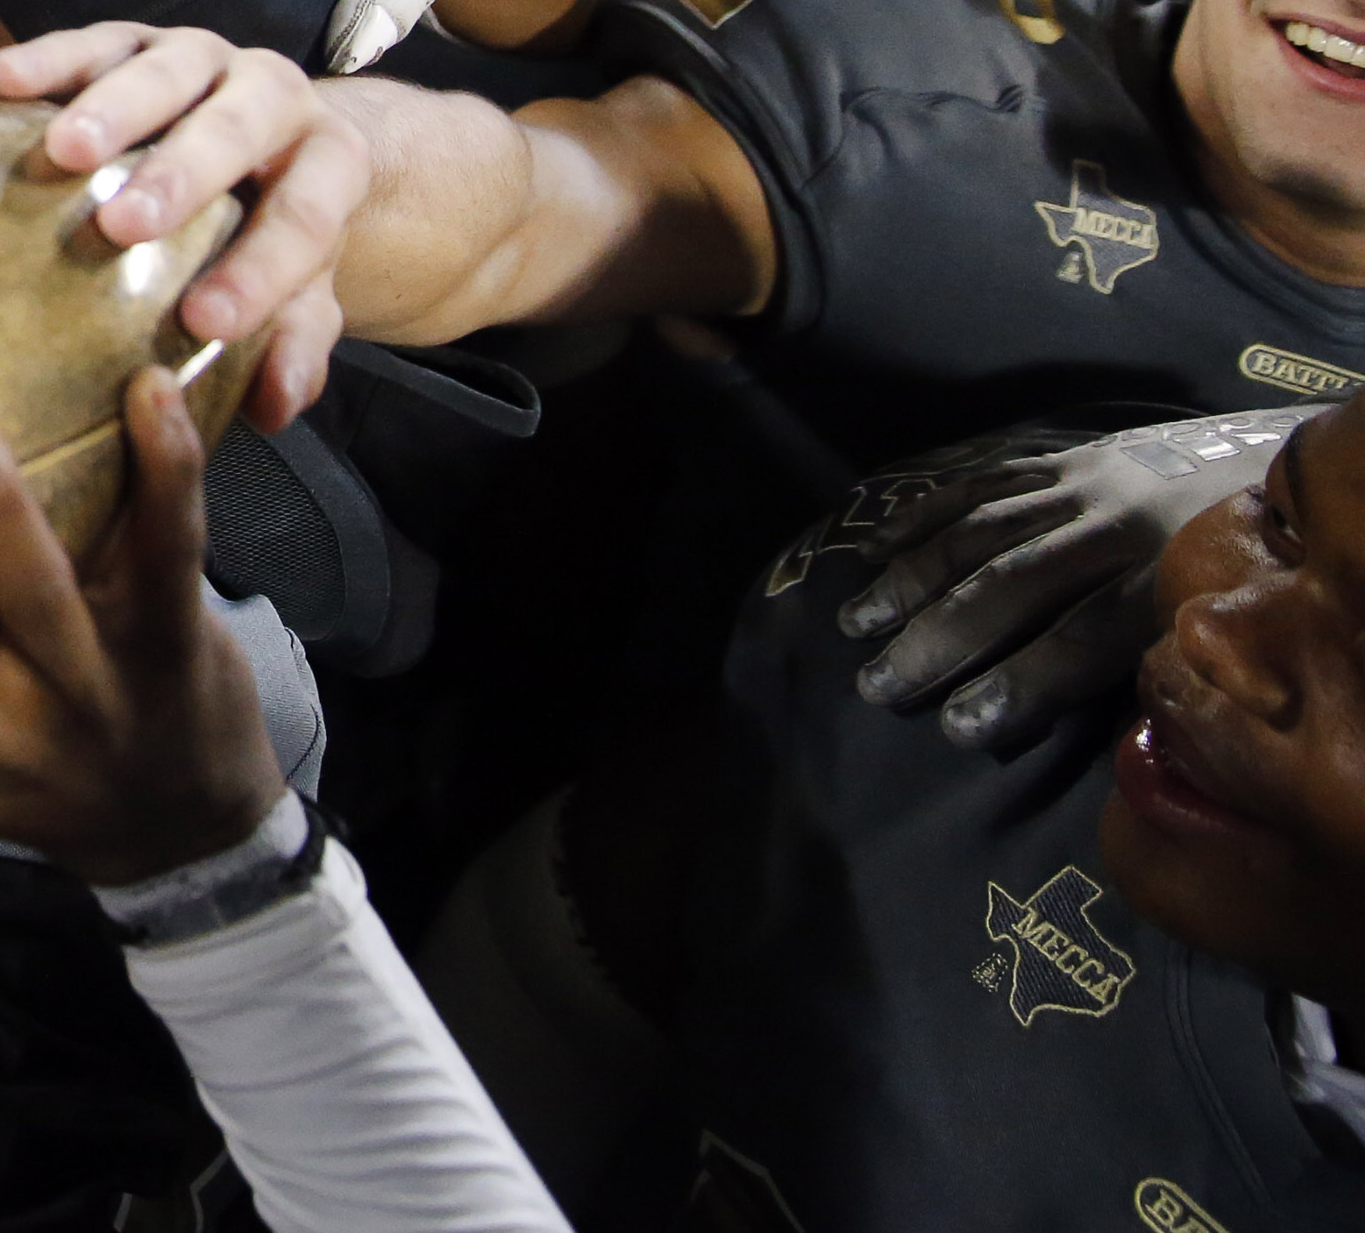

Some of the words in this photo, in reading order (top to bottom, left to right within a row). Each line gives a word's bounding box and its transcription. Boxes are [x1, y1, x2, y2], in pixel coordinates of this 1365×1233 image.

[1071, 207, 1156, 250] MECCA
[1251, 351, 1349, 392] BATT
[1011, 905, 1121, 1005] MECCA
